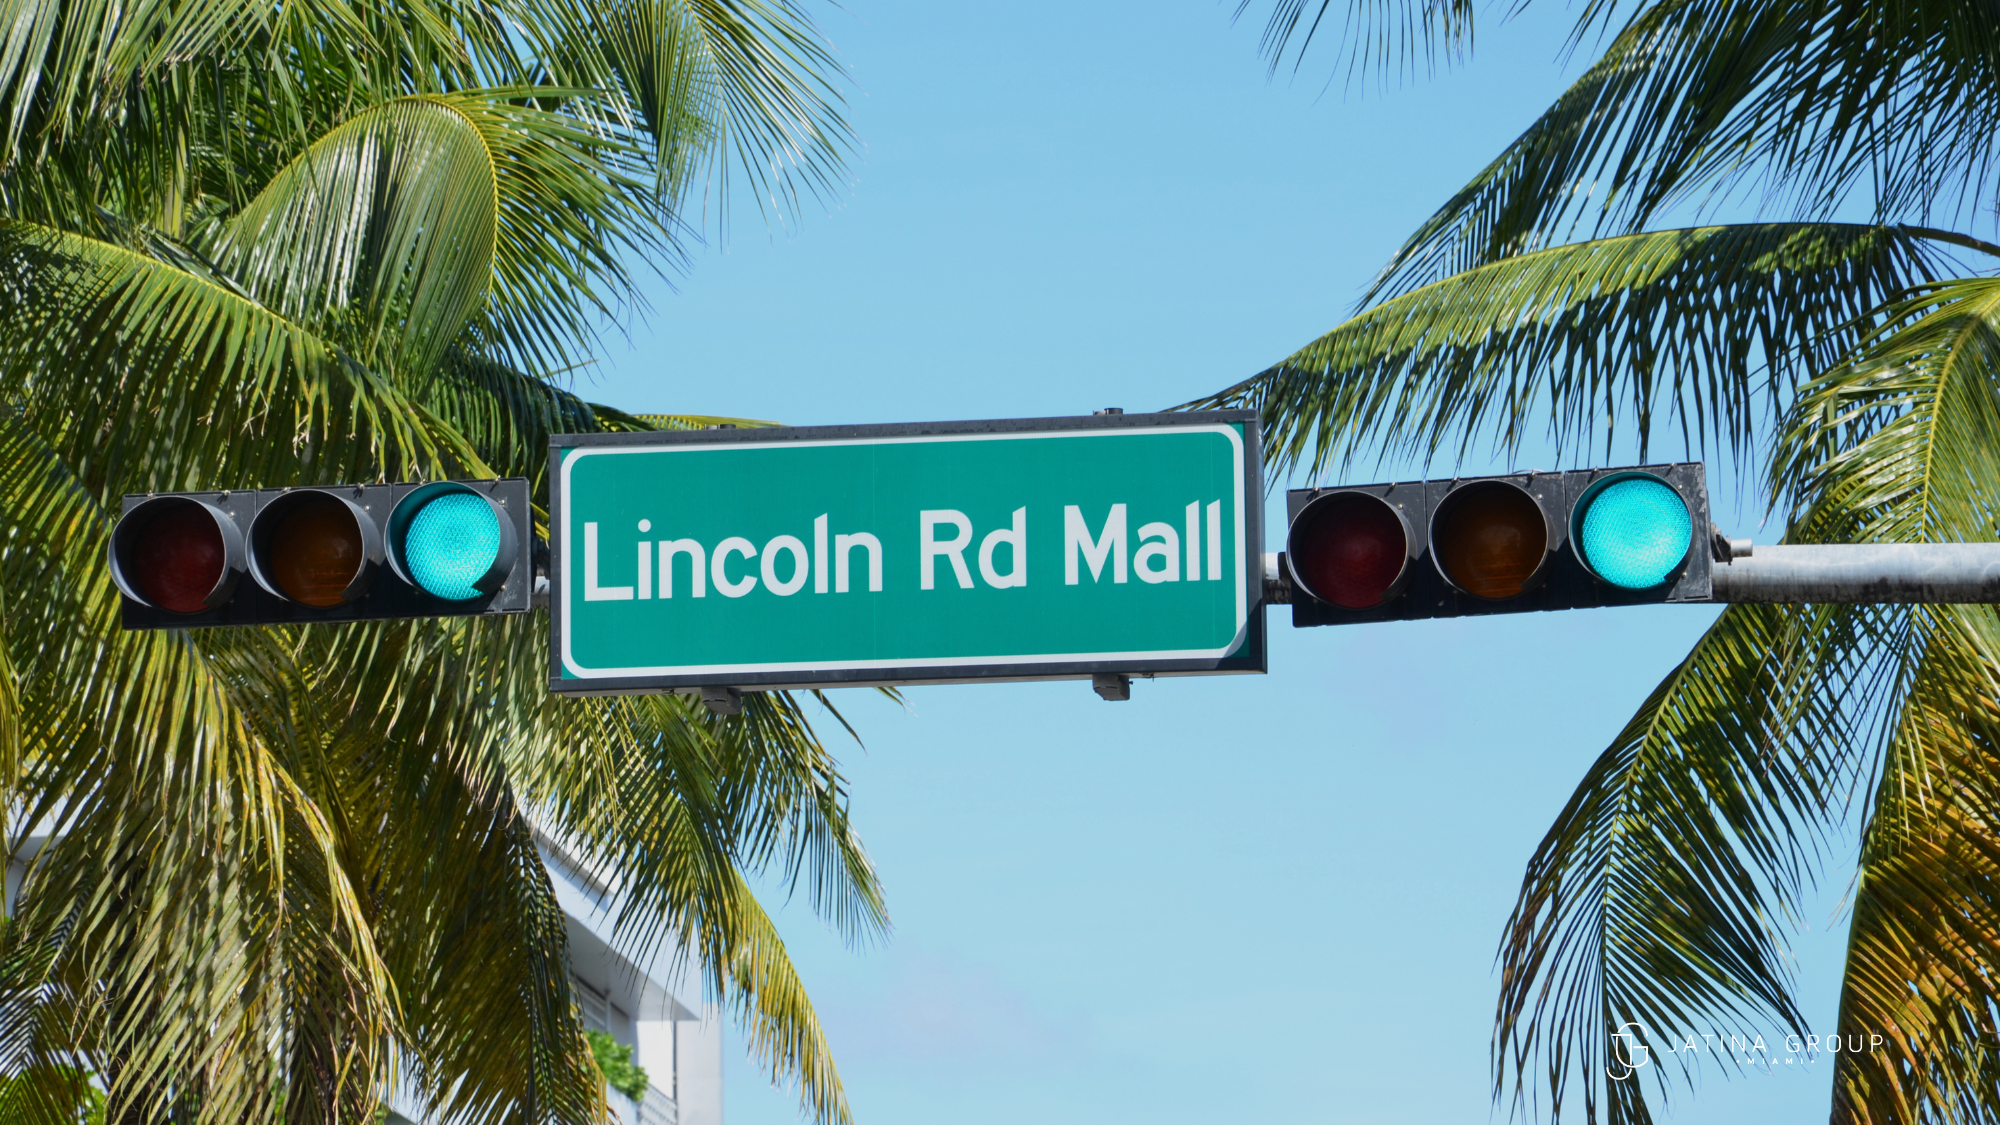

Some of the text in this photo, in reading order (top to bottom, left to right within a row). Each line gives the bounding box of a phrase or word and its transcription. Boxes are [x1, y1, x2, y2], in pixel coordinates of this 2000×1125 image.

[585, 500, 1221, 601] Lincoln Rd Mall
